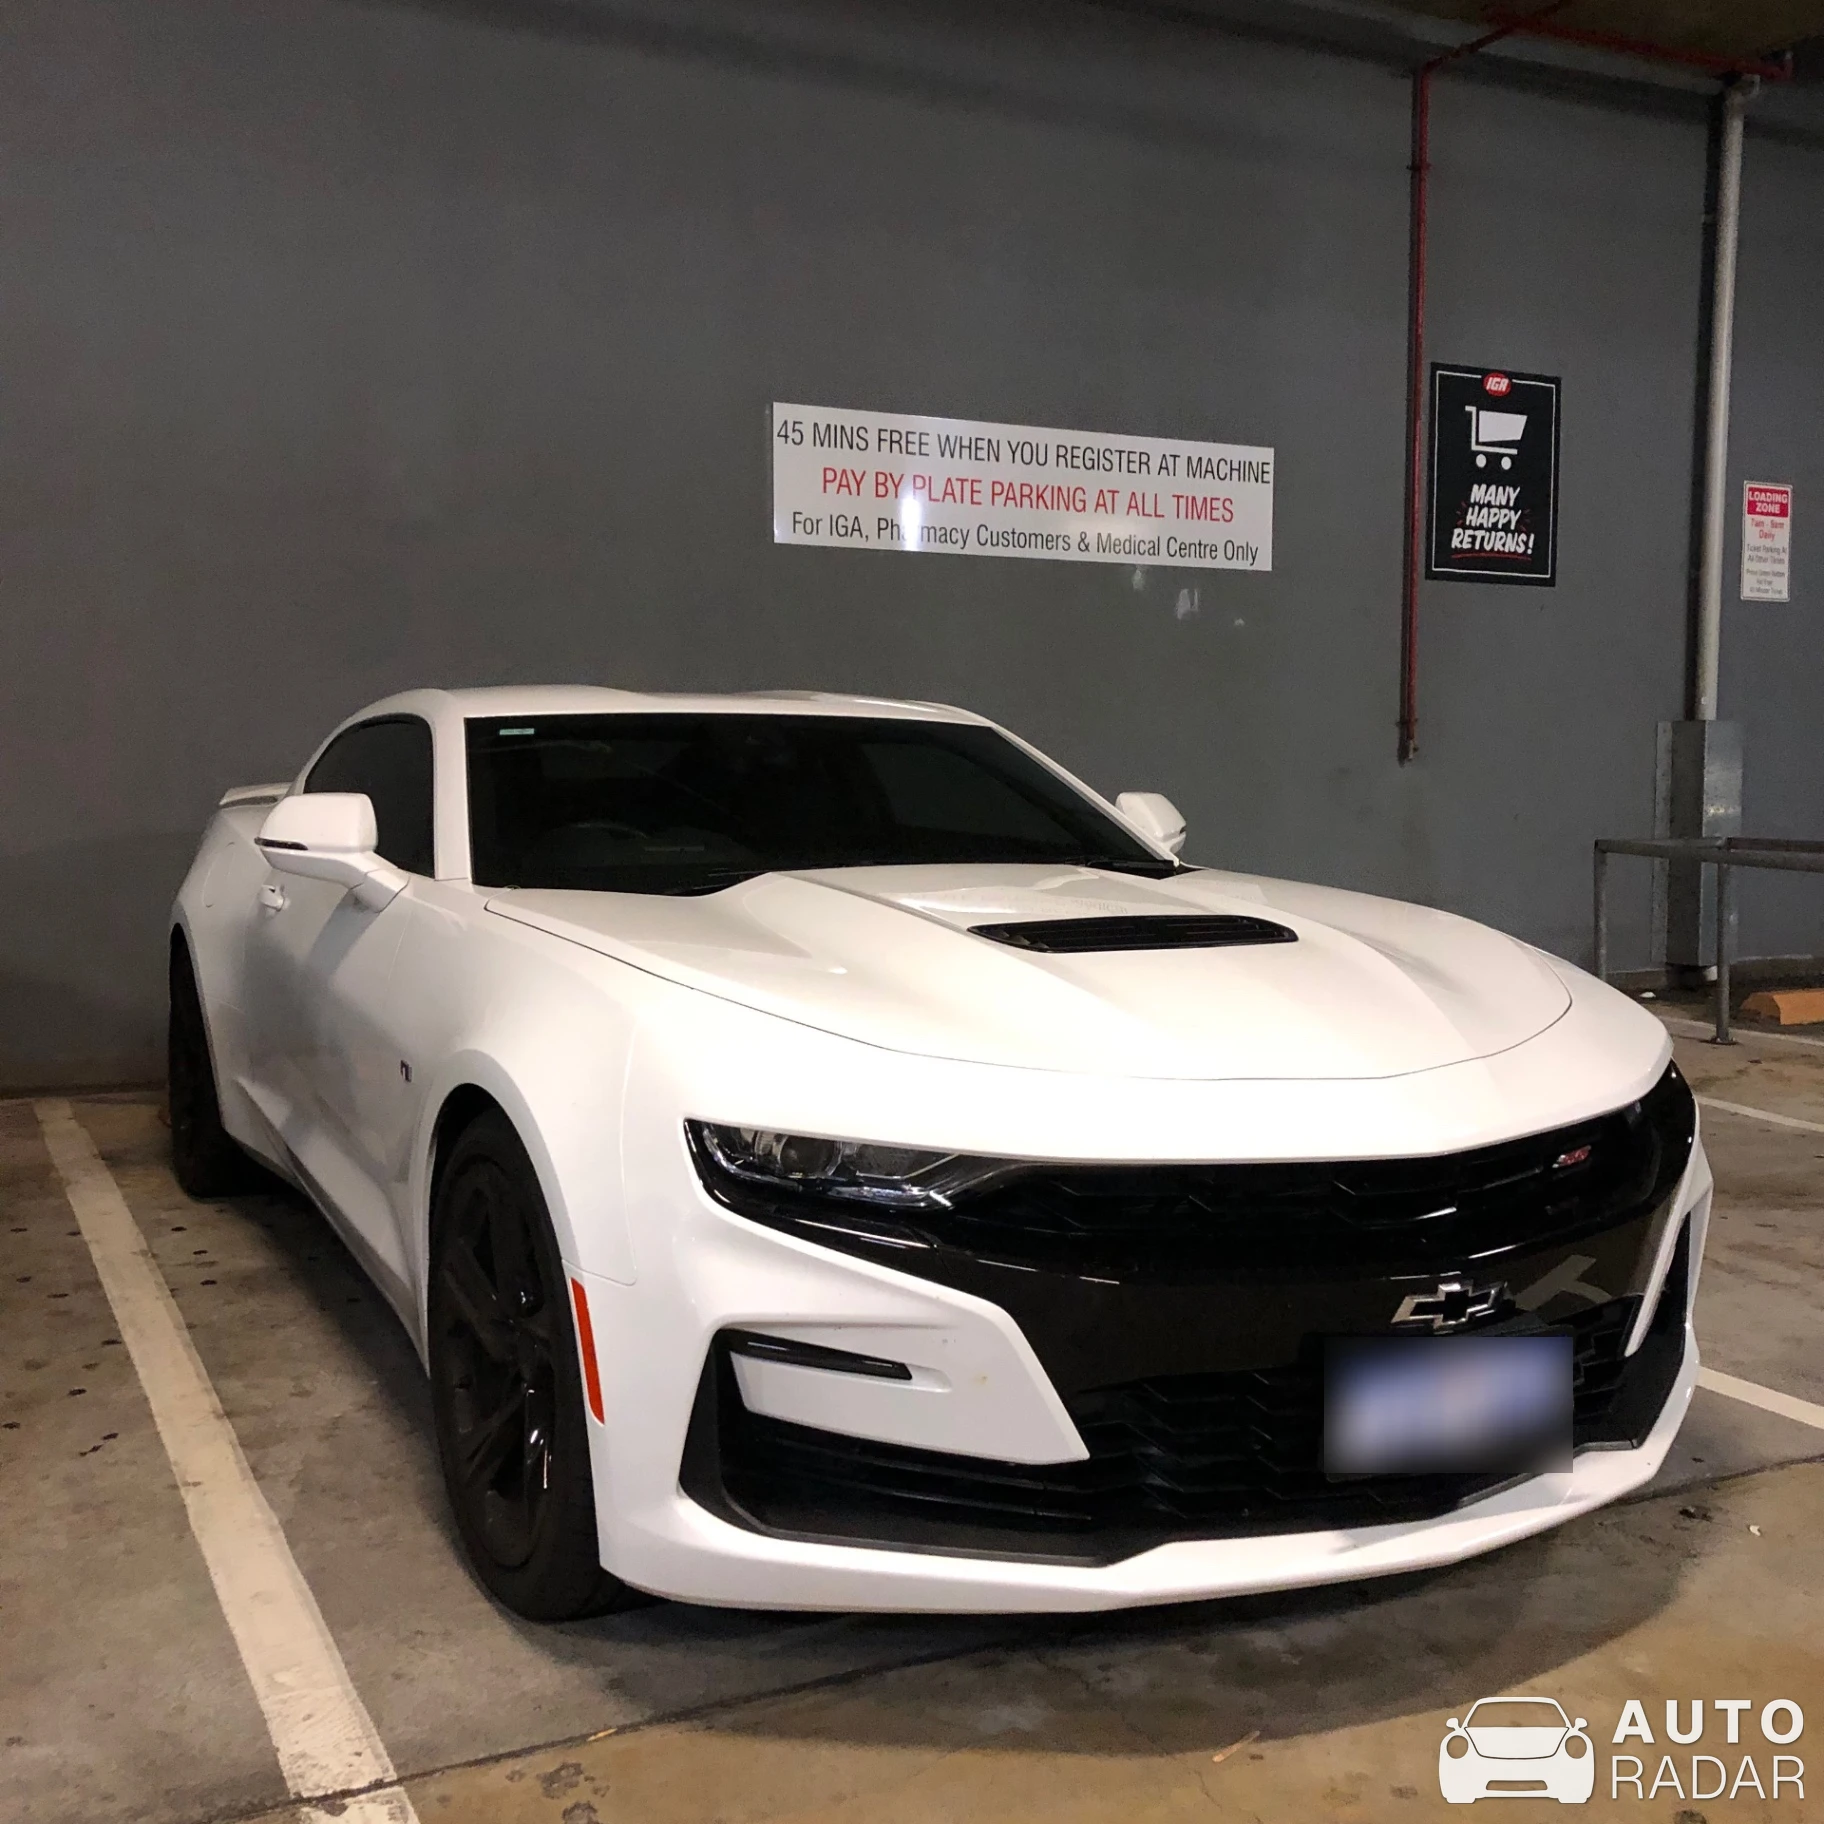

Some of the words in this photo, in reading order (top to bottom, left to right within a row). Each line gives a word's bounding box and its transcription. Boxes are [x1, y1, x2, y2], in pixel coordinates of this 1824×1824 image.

[1486, 376, 1509, 392] IGA
[777, 420, 804, 446] 45
[813, 422, 869, 451] MINS
[877, 428, 930, 457] FREE
[937, 433, 1000, 463] WHEN
[1007, 440, 1048, 467] YOU
[1056, 444, 1150, 475] REGISTER
[1157, 454, 1180, 477] AT
[1186, 456, 1271, 485] MACHINE
[822, 467, 866, 497] PAY
[875, 471, 904, 499] BY
[912, 474, 982, 506] PLATE
[991, 481, 1087, 513] PARKING
[1094, 489, 1120, 515] AT
[1126, 491, 1165, 519] ALL
[1172, 494, 1234, 523] TIMES
[1470, 483, 1521, 507] MANY
[1749, 491, 1788, 504] LOADING
[1465, 505, 1522, 530] HAPPY
[1756, 503, 1780, 514] ZONE
[792, 511, 823, 536] For
[829, 514, 869, 542] IGA,
[877, 517, 970, 550] Phmacy
[976, 524, 1071, 552] Customers
[1077, 531, 1090, 552] &
[1096, 532, 1160, 557] Medical
[1166, 536, 1218, 560] Centre
[1224, 540, 1258, 566] Only
[1451, 528, 1535, 555] RETURNS!
[1759, 529, 1775, 542] Daily
